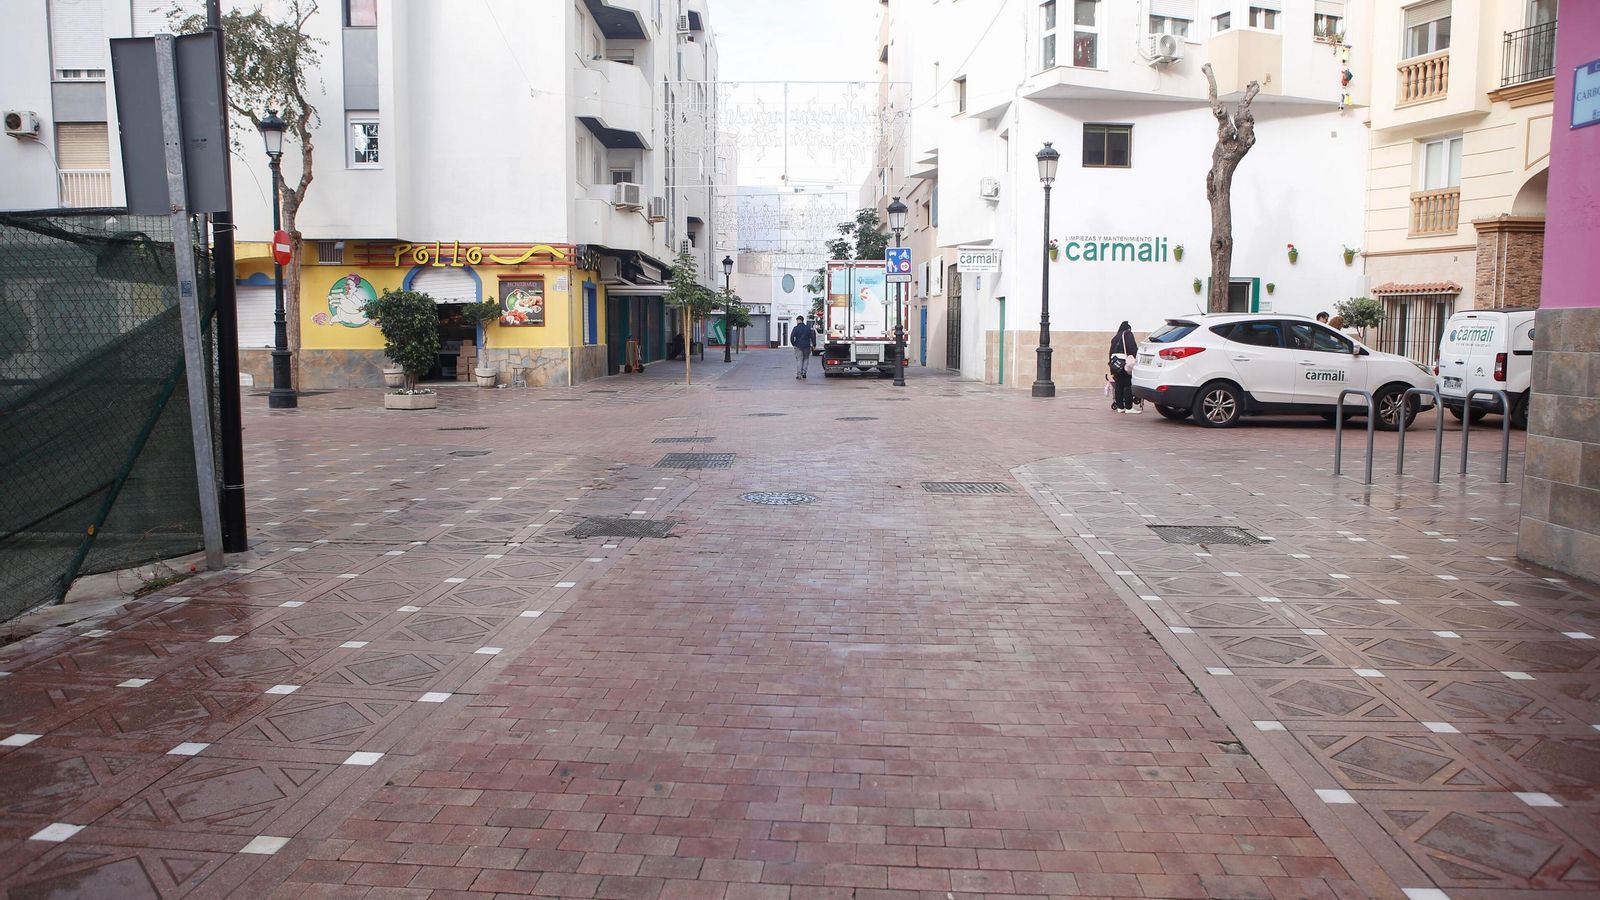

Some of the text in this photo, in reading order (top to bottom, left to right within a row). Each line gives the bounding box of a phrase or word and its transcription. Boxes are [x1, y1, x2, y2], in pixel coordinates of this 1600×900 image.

[1065, 237, 1167, 262] carmali
[960, 252, 998, 264] carmali
[1456, 326, 1495, 342] carmali
[1305, 370, 1345, 381] carmali
